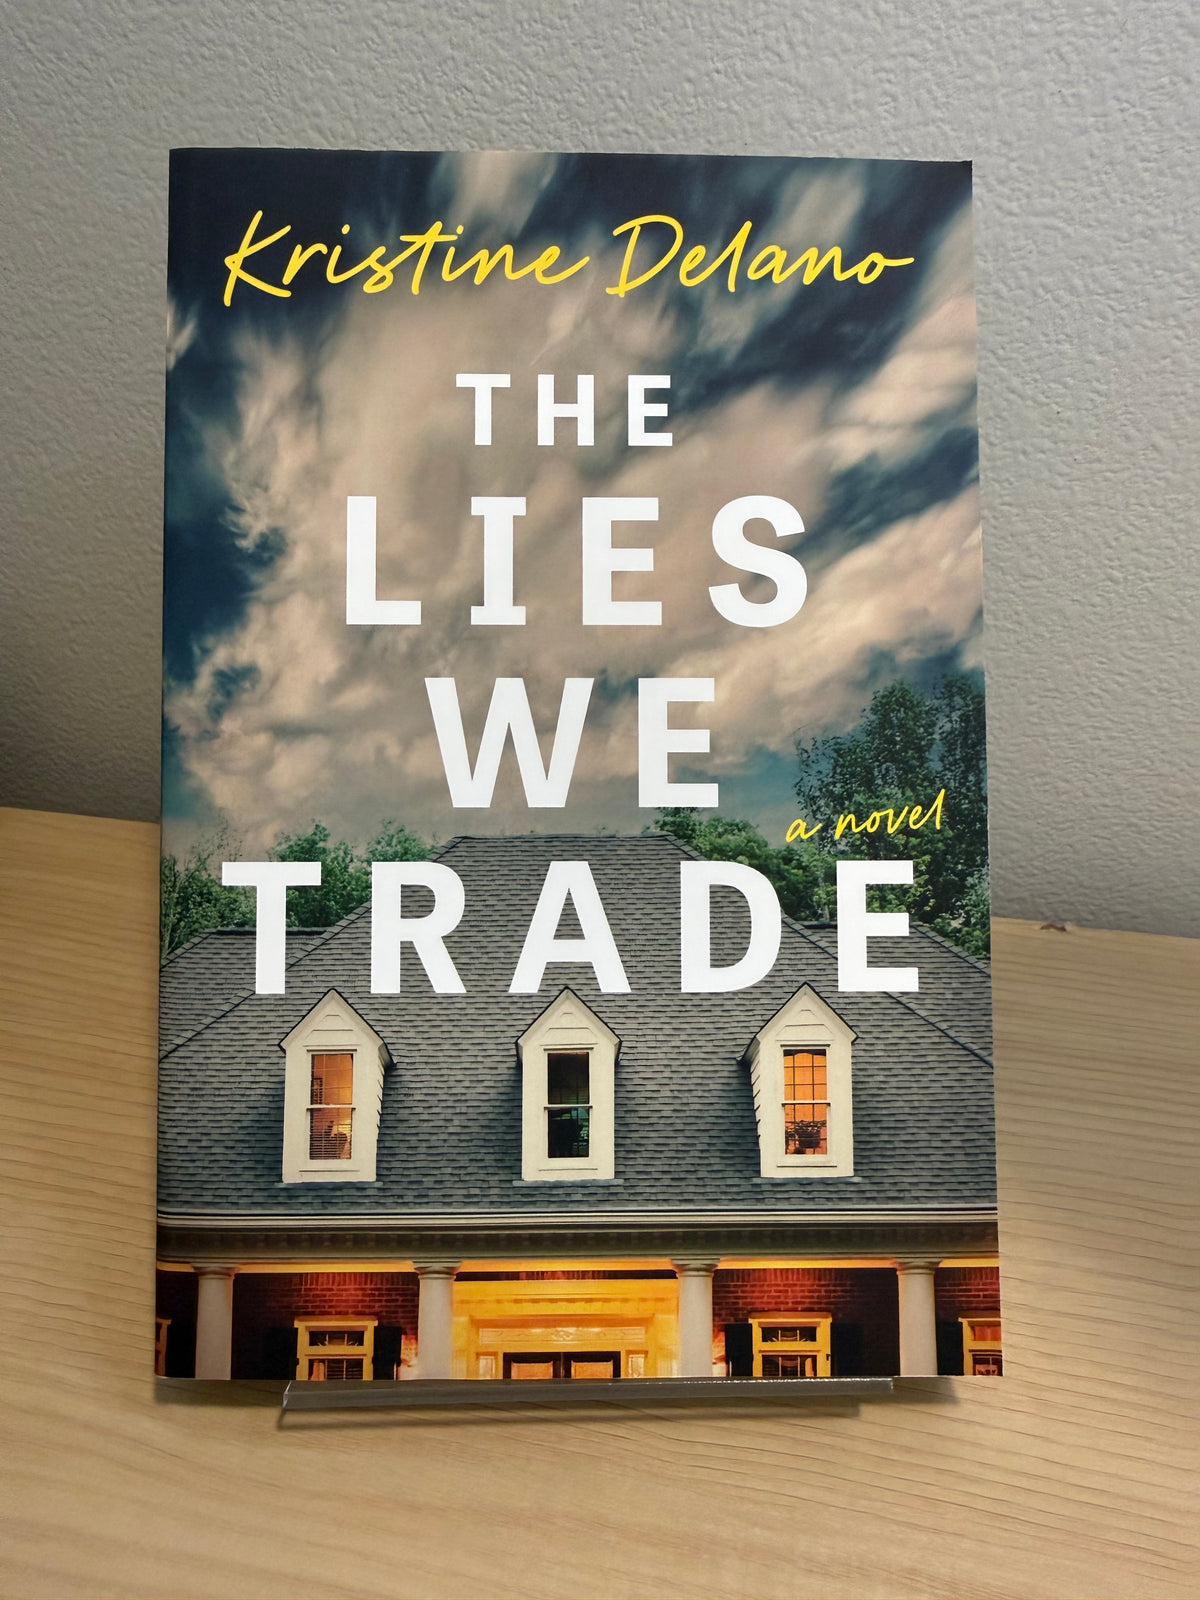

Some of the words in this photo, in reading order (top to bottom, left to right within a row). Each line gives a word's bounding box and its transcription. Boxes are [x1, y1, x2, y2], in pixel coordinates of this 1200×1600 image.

[223, 210, 590, 306] Kristine
[605, 214, 914, 297] Delano
[455, 373, 674, 448] THE
[345, 495, 808, 628] LIES
[424, 677, 720, 809] WE
[785, 818, 821, 843] a
[834, 789, 947, 840] novel
[221, 860, 920, 996] TRADE
